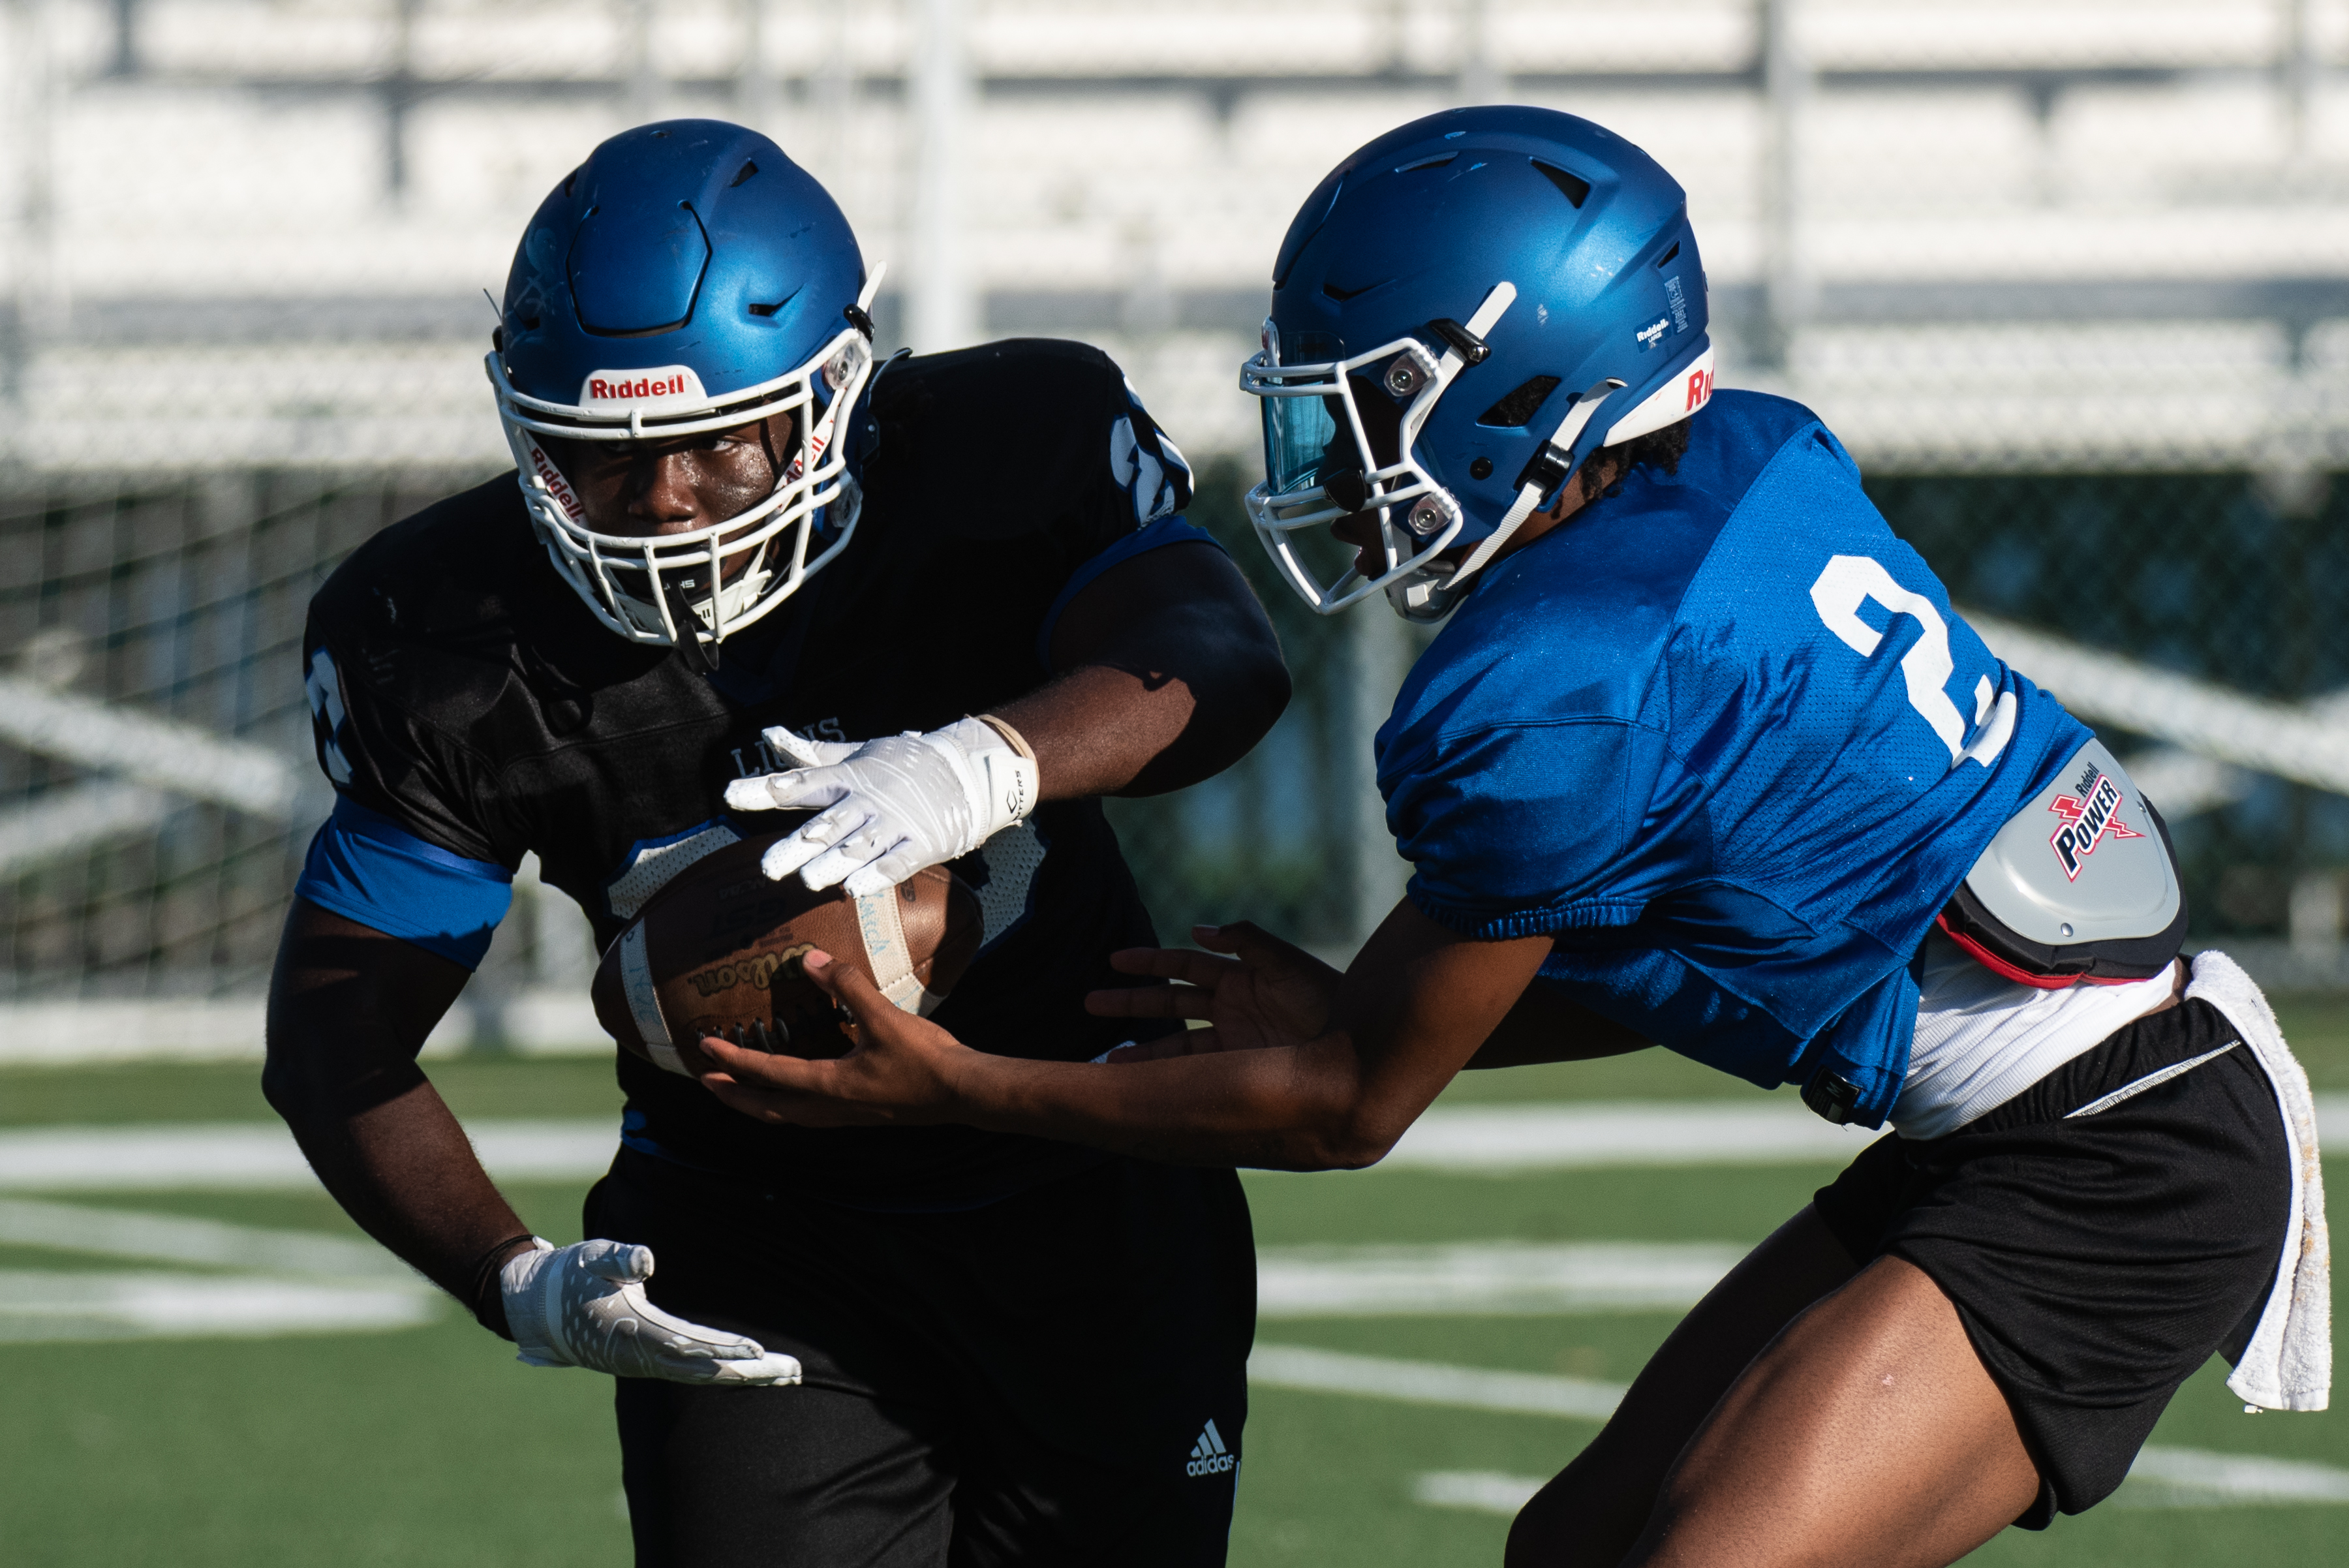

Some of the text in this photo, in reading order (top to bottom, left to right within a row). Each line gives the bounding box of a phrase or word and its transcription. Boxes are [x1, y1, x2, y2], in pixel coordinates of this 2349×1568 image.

[1636, 318, 1667, 342] Riddell
[590, 375, 684, 399] Riddell
[531, 447, 584, 518] Riddell
[1809, 555, 2017, 770] 2
[2075, 761, 2100, 798] Riddell
[2053, 777, 2120, 878] POWER
[1186, 1453, 1235, 1477] adidas
